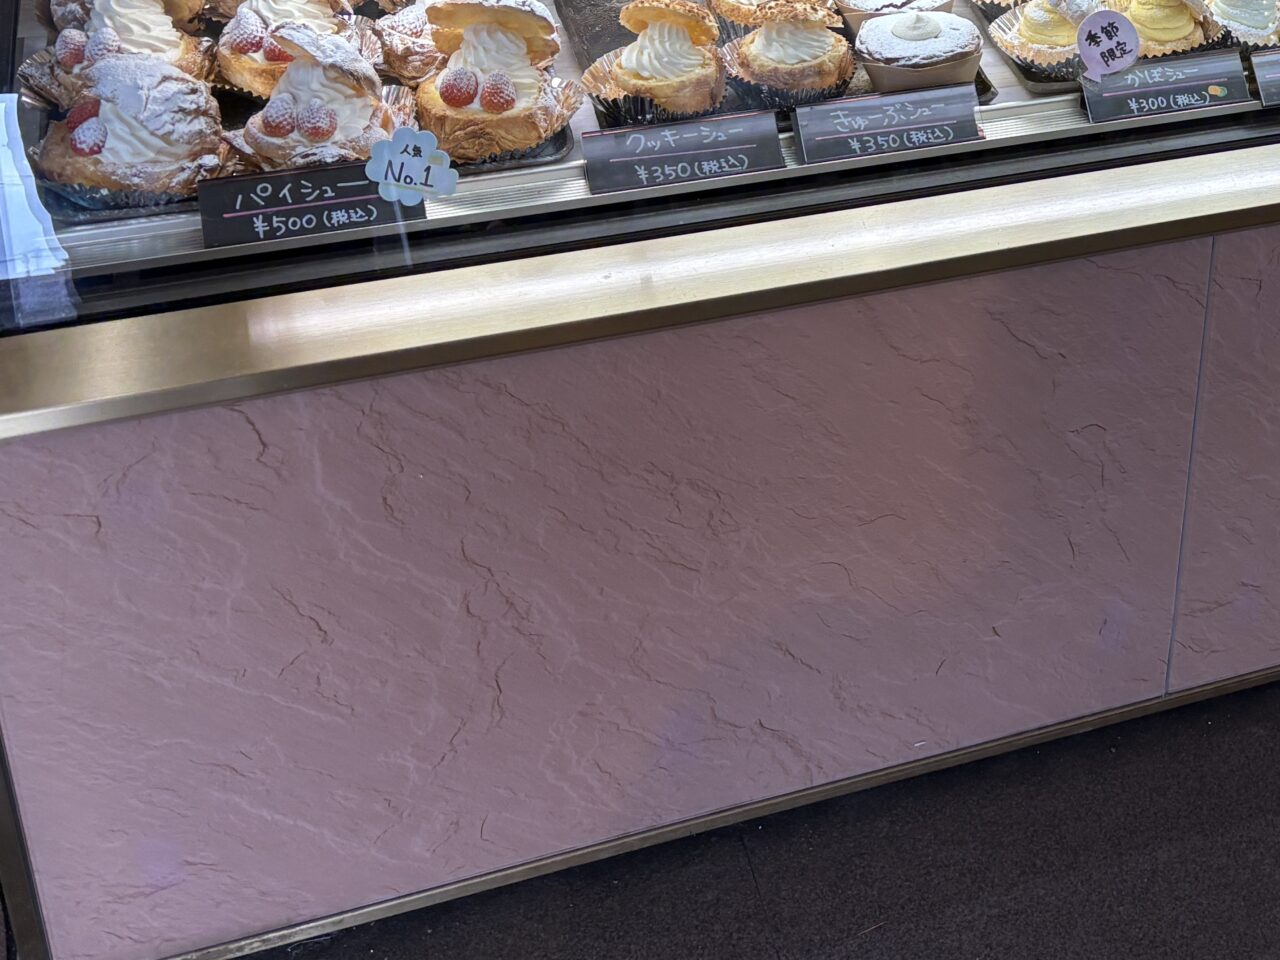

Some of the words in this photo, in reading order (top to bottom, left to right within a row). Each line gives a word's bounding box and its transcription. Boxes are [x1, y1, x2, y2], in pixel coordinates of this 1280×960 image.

[1084, 20, 1120, 49] 季節
[1099, 40, 1134, 68] 限定
[400, 144, 424, 158] 人気
[384, 159, 435, 188] No.1
[234, 179, 370, 210] パイシュー
